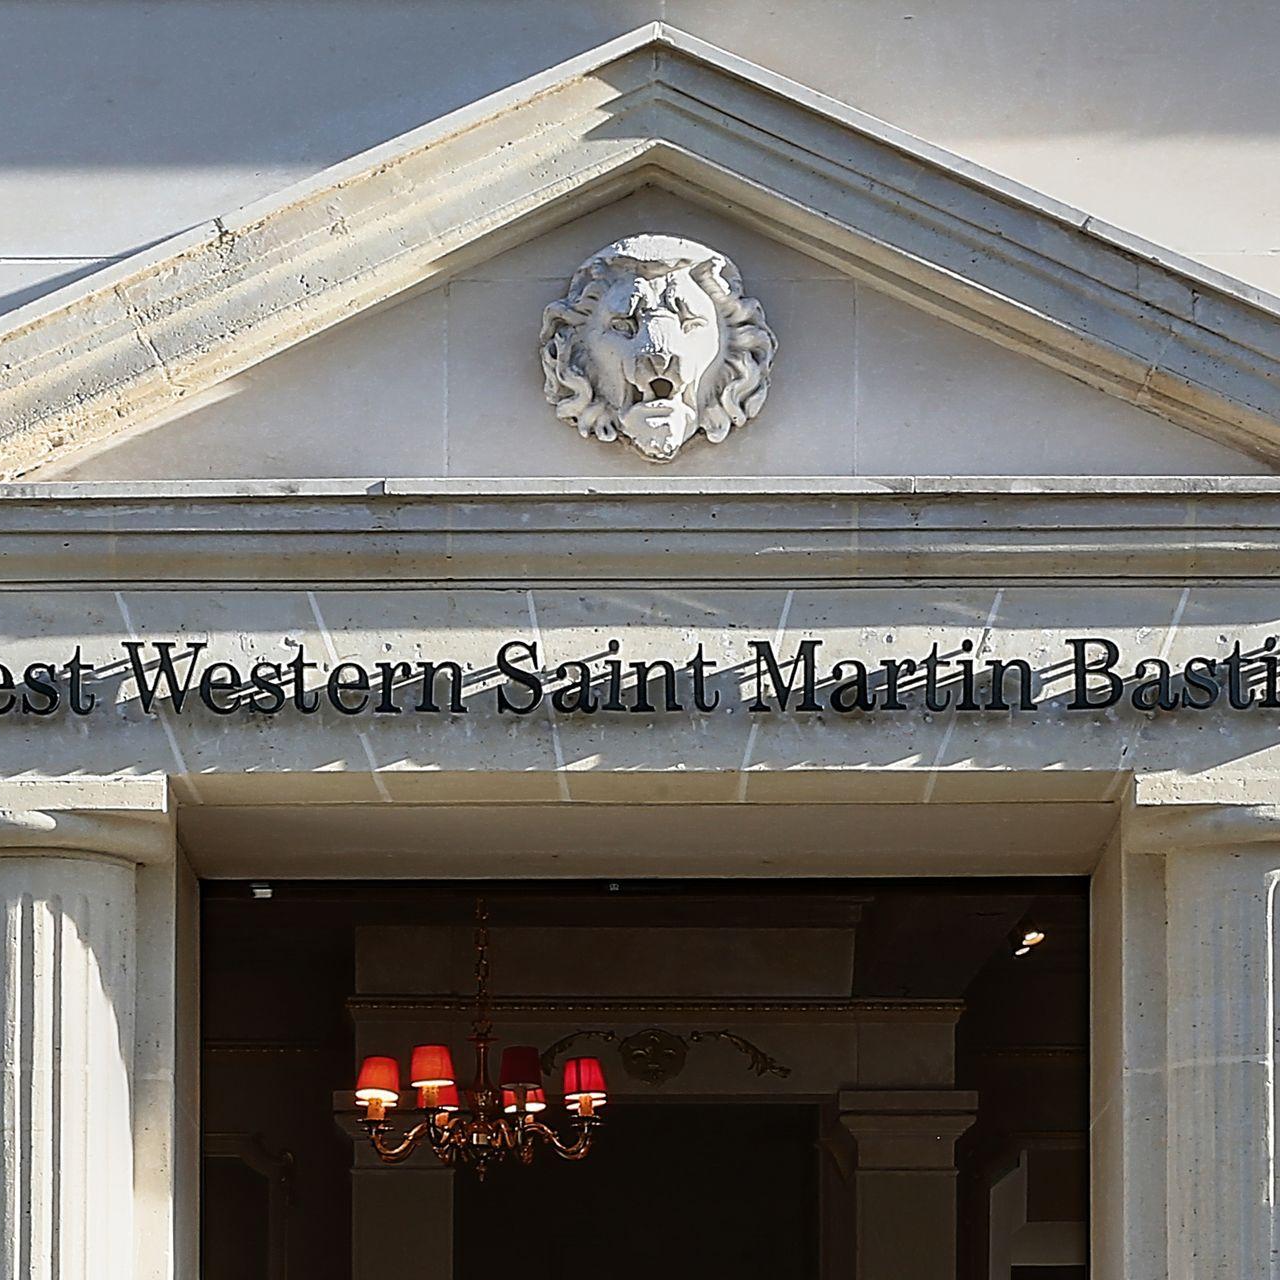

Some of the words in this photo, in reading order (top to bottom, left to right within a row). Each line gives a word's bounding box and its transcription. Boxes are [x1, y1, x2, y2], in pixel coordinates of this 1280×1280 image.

[120, 640, 464, 716] Western
[495, 638, 720, 715] Saint
[747, 637, 1038, 713] Martin
